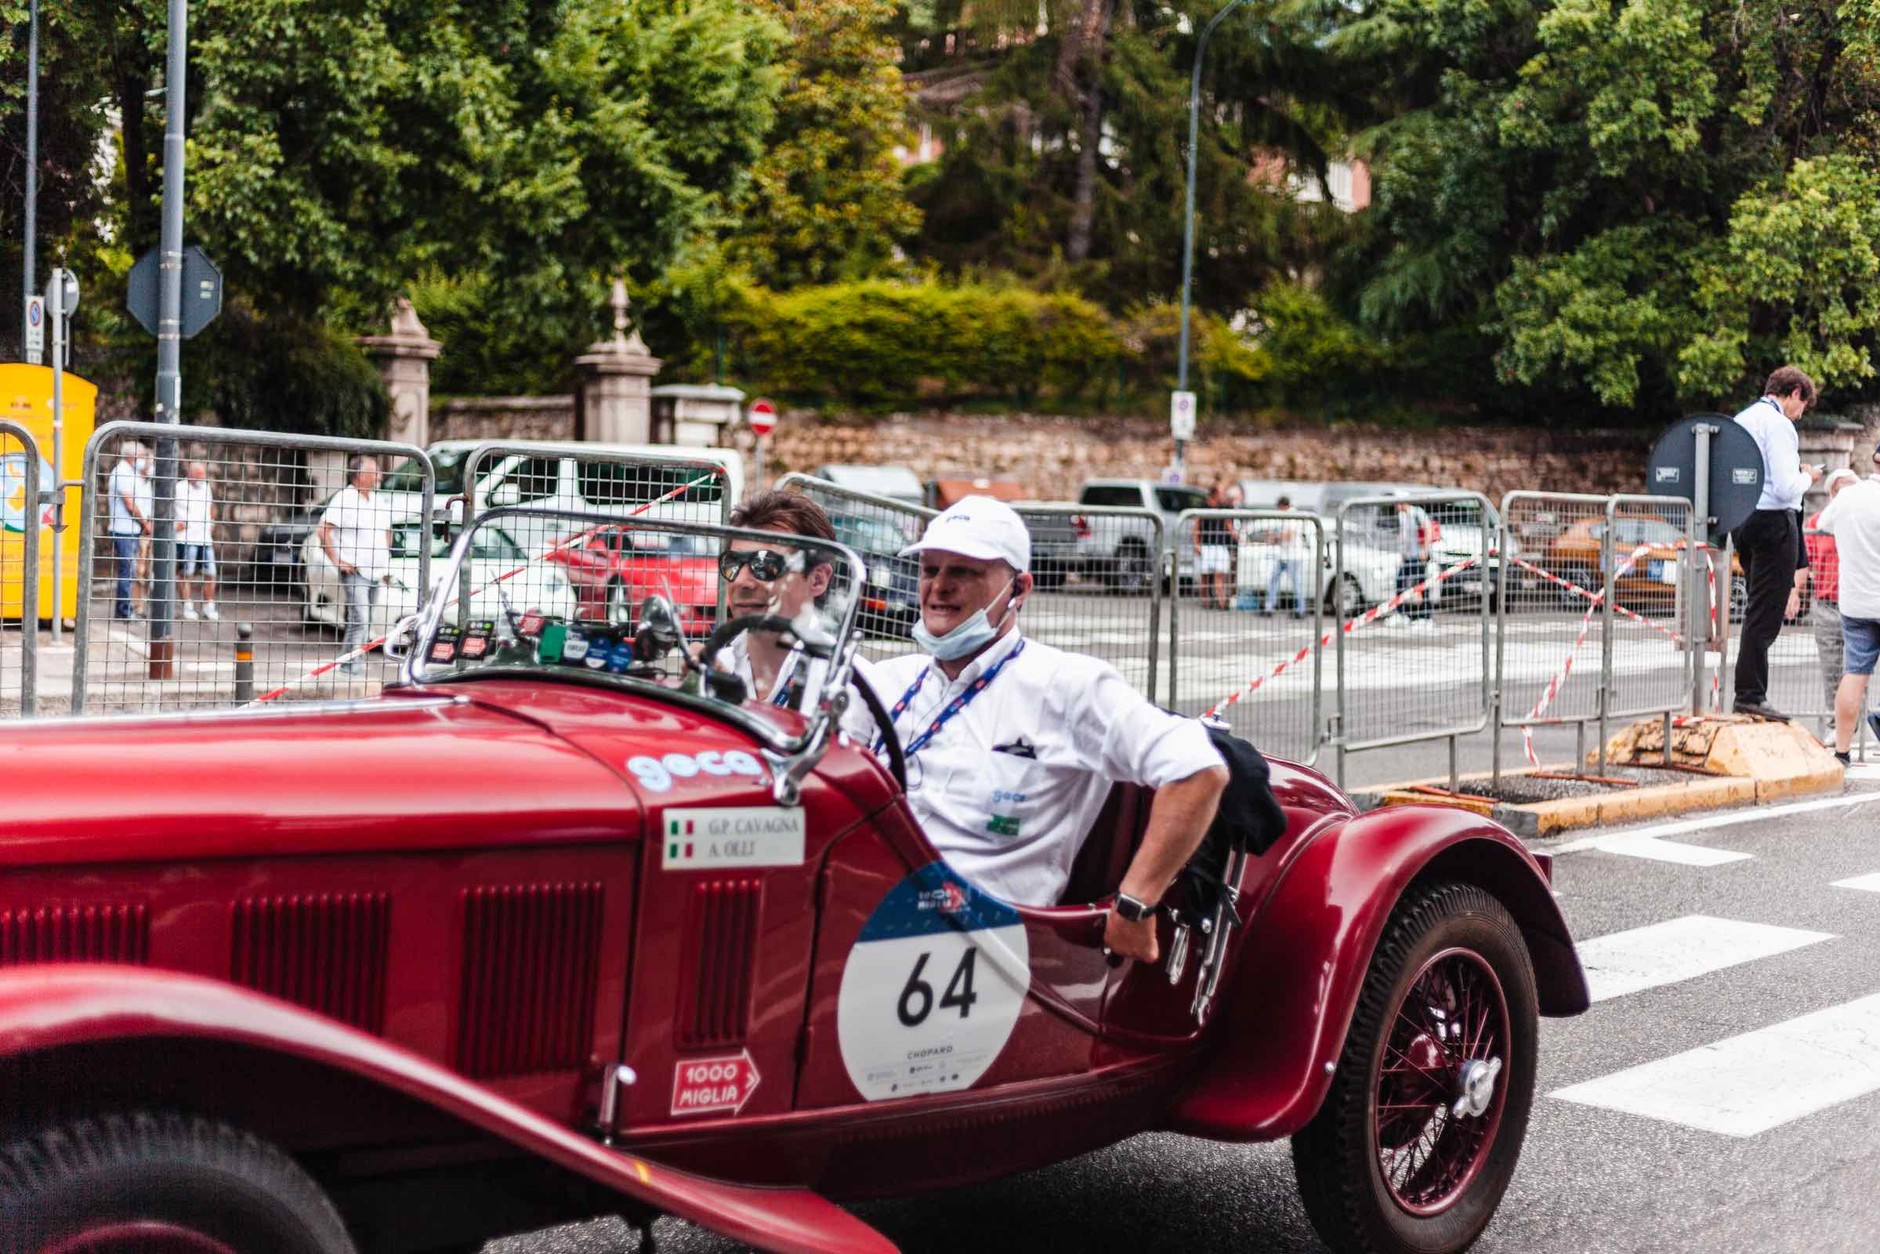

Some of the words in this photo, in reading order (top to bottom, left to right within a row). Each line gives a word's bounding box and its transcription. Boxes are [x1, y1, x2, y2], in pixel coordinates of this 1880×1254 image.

[735, 815, 799, 833] CAVAGNA
[724, 840, 756, 857] OLLI
[897, 946, 977, 1028] 64
[907, 1045, 953, 1060] CHOPARD
[686, 1063, 738, 1083] 1000
[679, 1085, 738, 1106] MIGLIA
